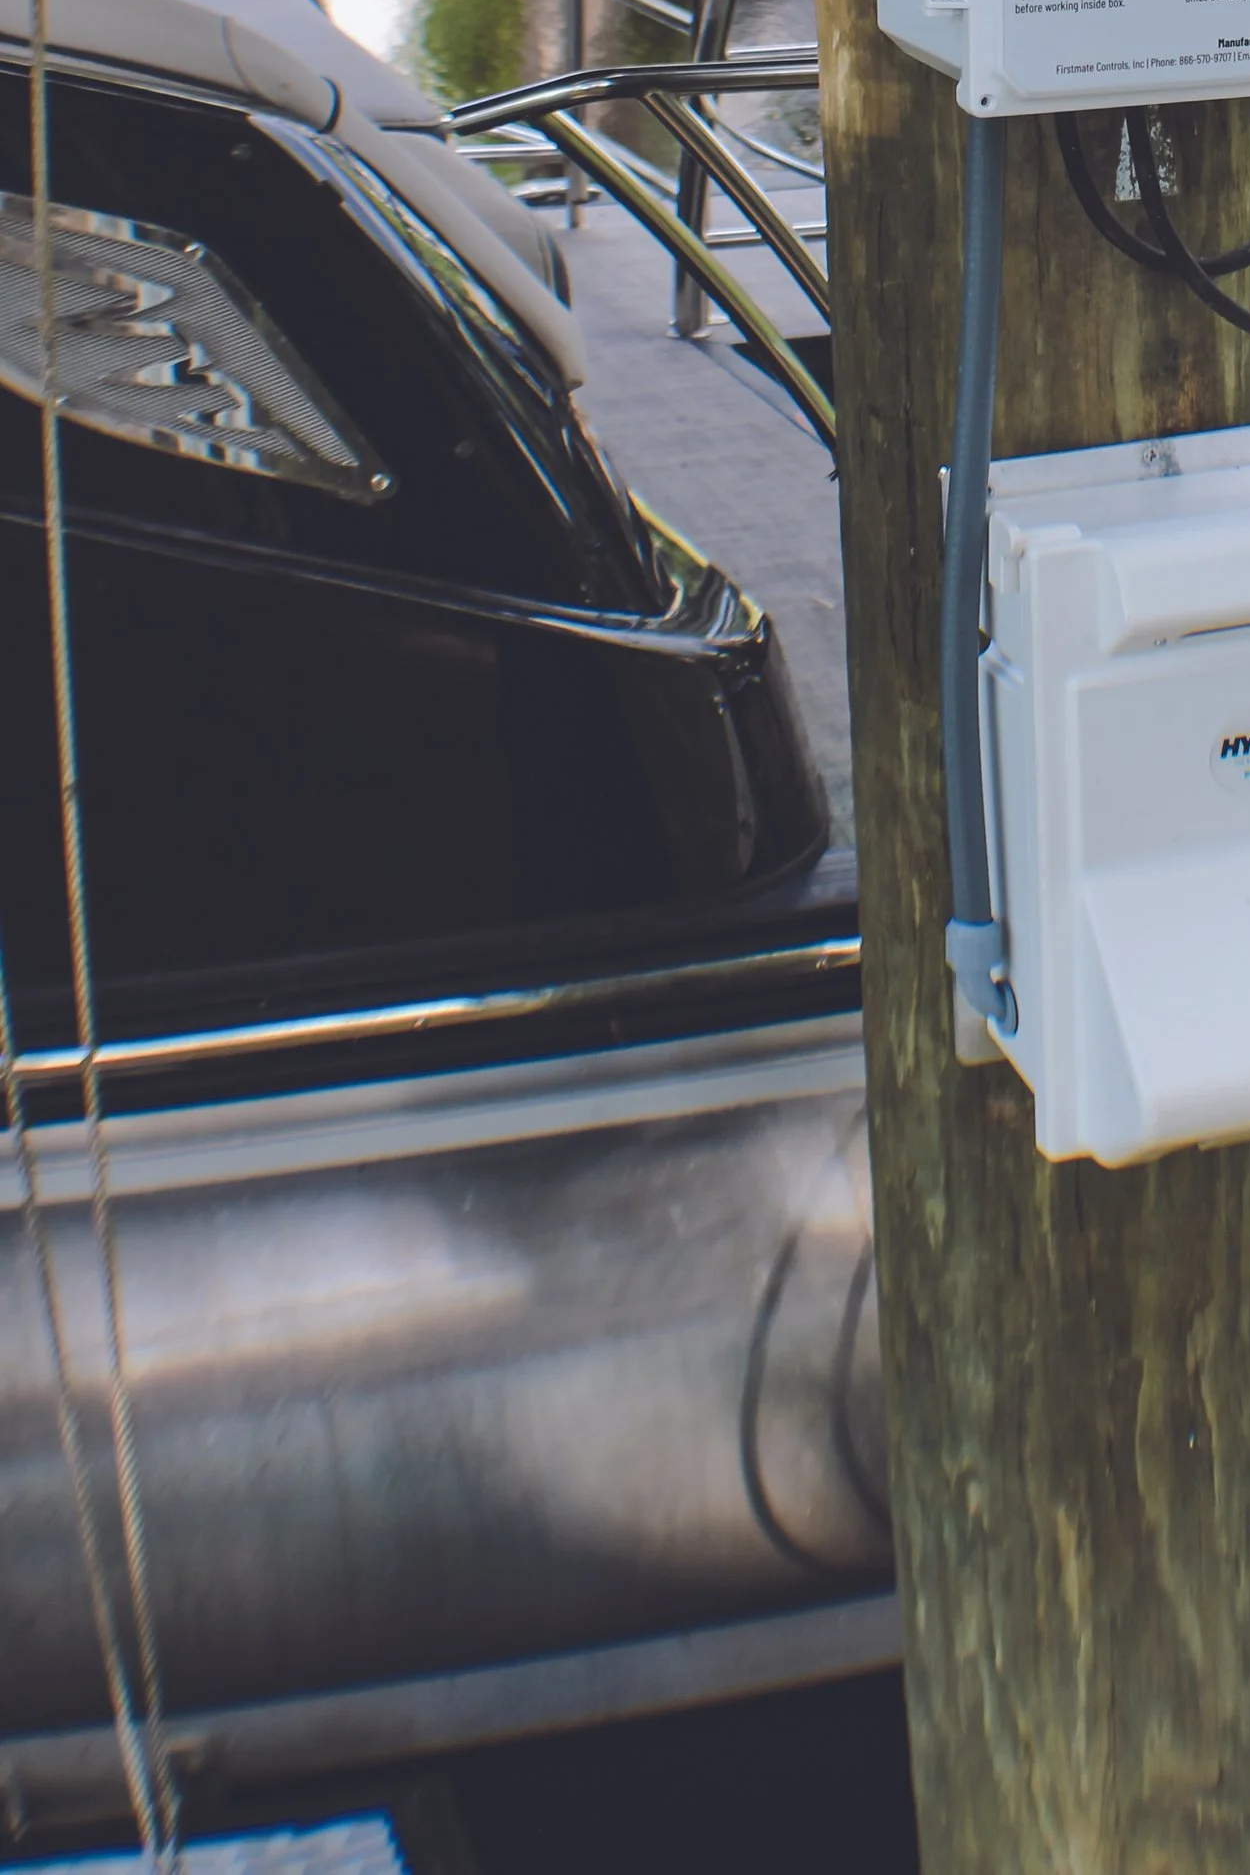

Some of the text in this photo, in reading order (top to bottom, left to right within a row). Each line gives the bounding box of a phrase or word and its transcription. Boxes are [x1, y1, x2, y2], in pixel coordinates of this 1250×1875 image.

[1014, 2, 1043, 14] before
[1044, 0, 1079, 13] working
[1055, 63, 1095, 75] Firstmate
[1095, 60, 1131, 72] Controls,
[1132, 60, 1145, 69] Inc
[1150, 57, 1177, 67] Phone:
[1178, 51, 1232, 65] 866-570-9707
